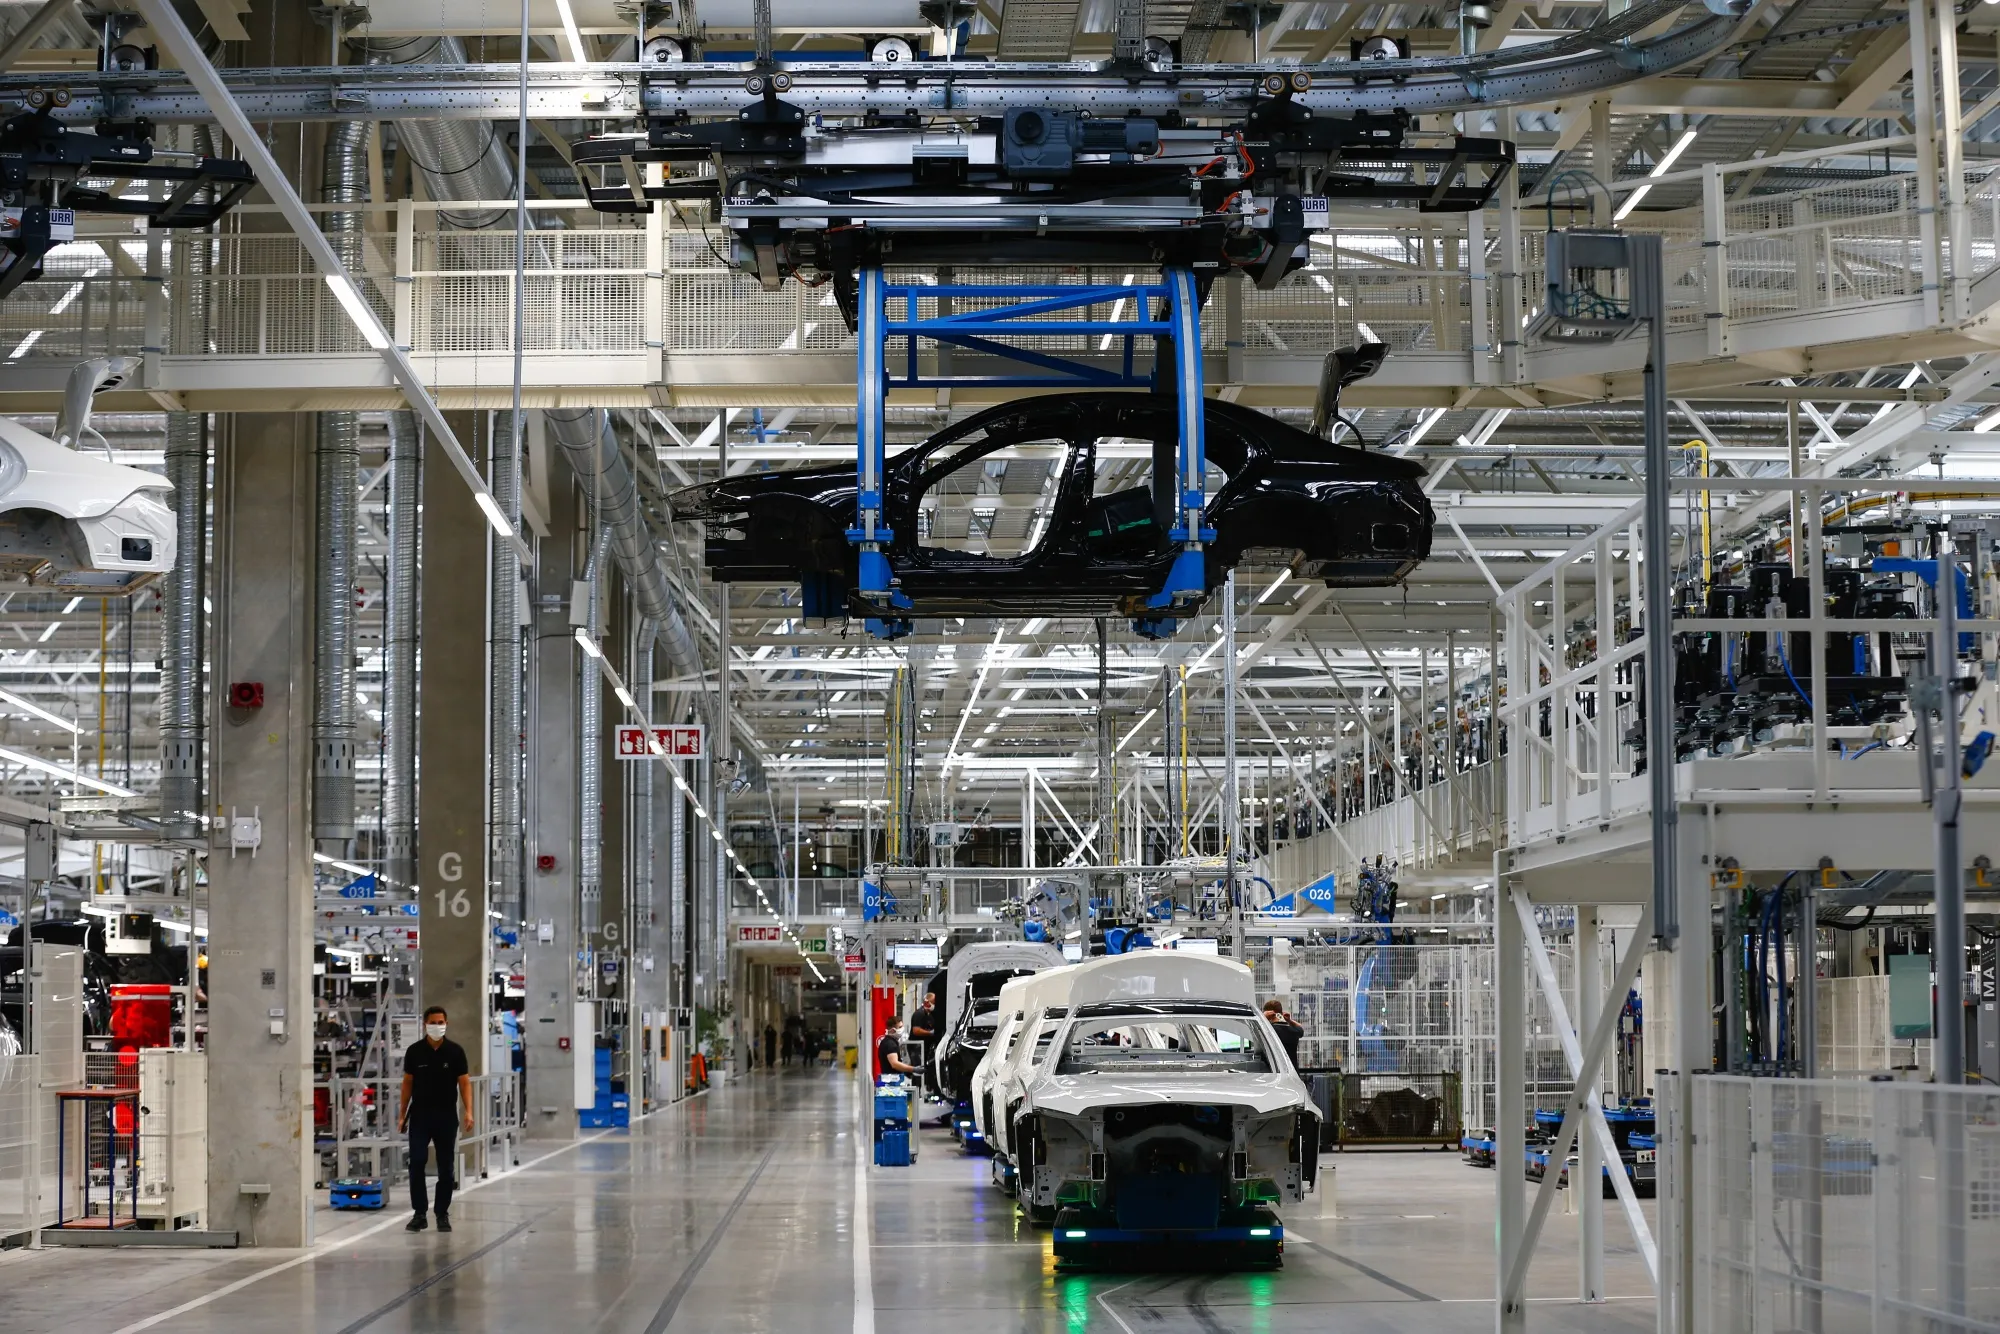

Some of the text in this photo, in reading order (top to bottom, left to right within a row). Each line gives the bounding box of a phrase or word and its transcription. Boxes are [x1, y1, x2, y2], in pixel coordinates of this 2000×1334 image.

[51, 209, 71, 223] ÜRR
[438, 851, 462, 882] G
[350, 887, 371, 899] 031
[1309, 889, 1331, 900] 026
[434, 888, 471, 918] 16
[603, 922, 619, 941] G
[1983, 966, 1995, 997] MA
